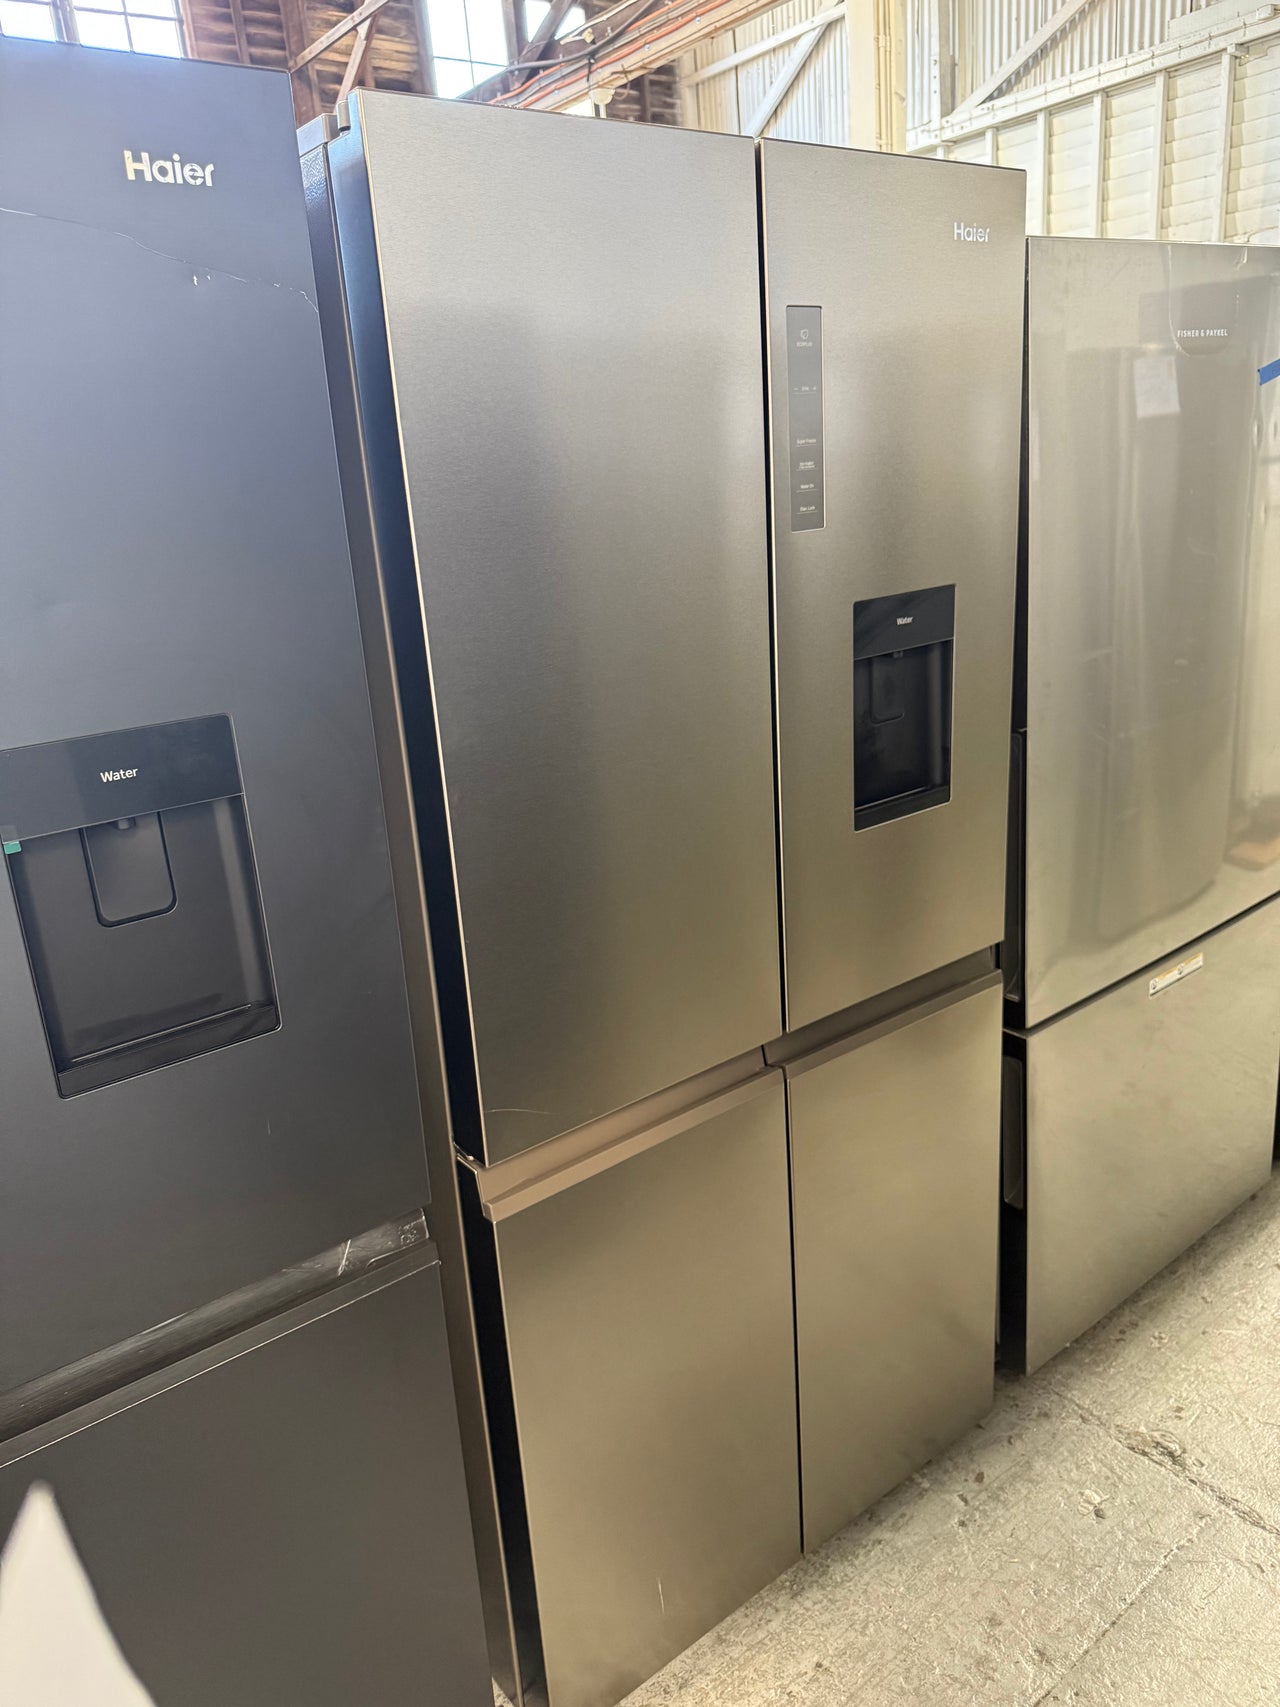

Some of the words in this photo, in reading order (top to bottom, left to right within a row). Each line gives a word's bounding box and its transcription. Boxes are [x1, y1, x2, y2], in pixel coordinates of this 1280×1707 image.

[123, 149, 214, 187] Haier
[953, 221, 990, 242] Haier
[1177, 329, 1199, 338] FISHER
[1206, 328, 1228, 337] PAYKEL
[896, 616, 913, 625] Water
[100, 768, 138, 783] Water
